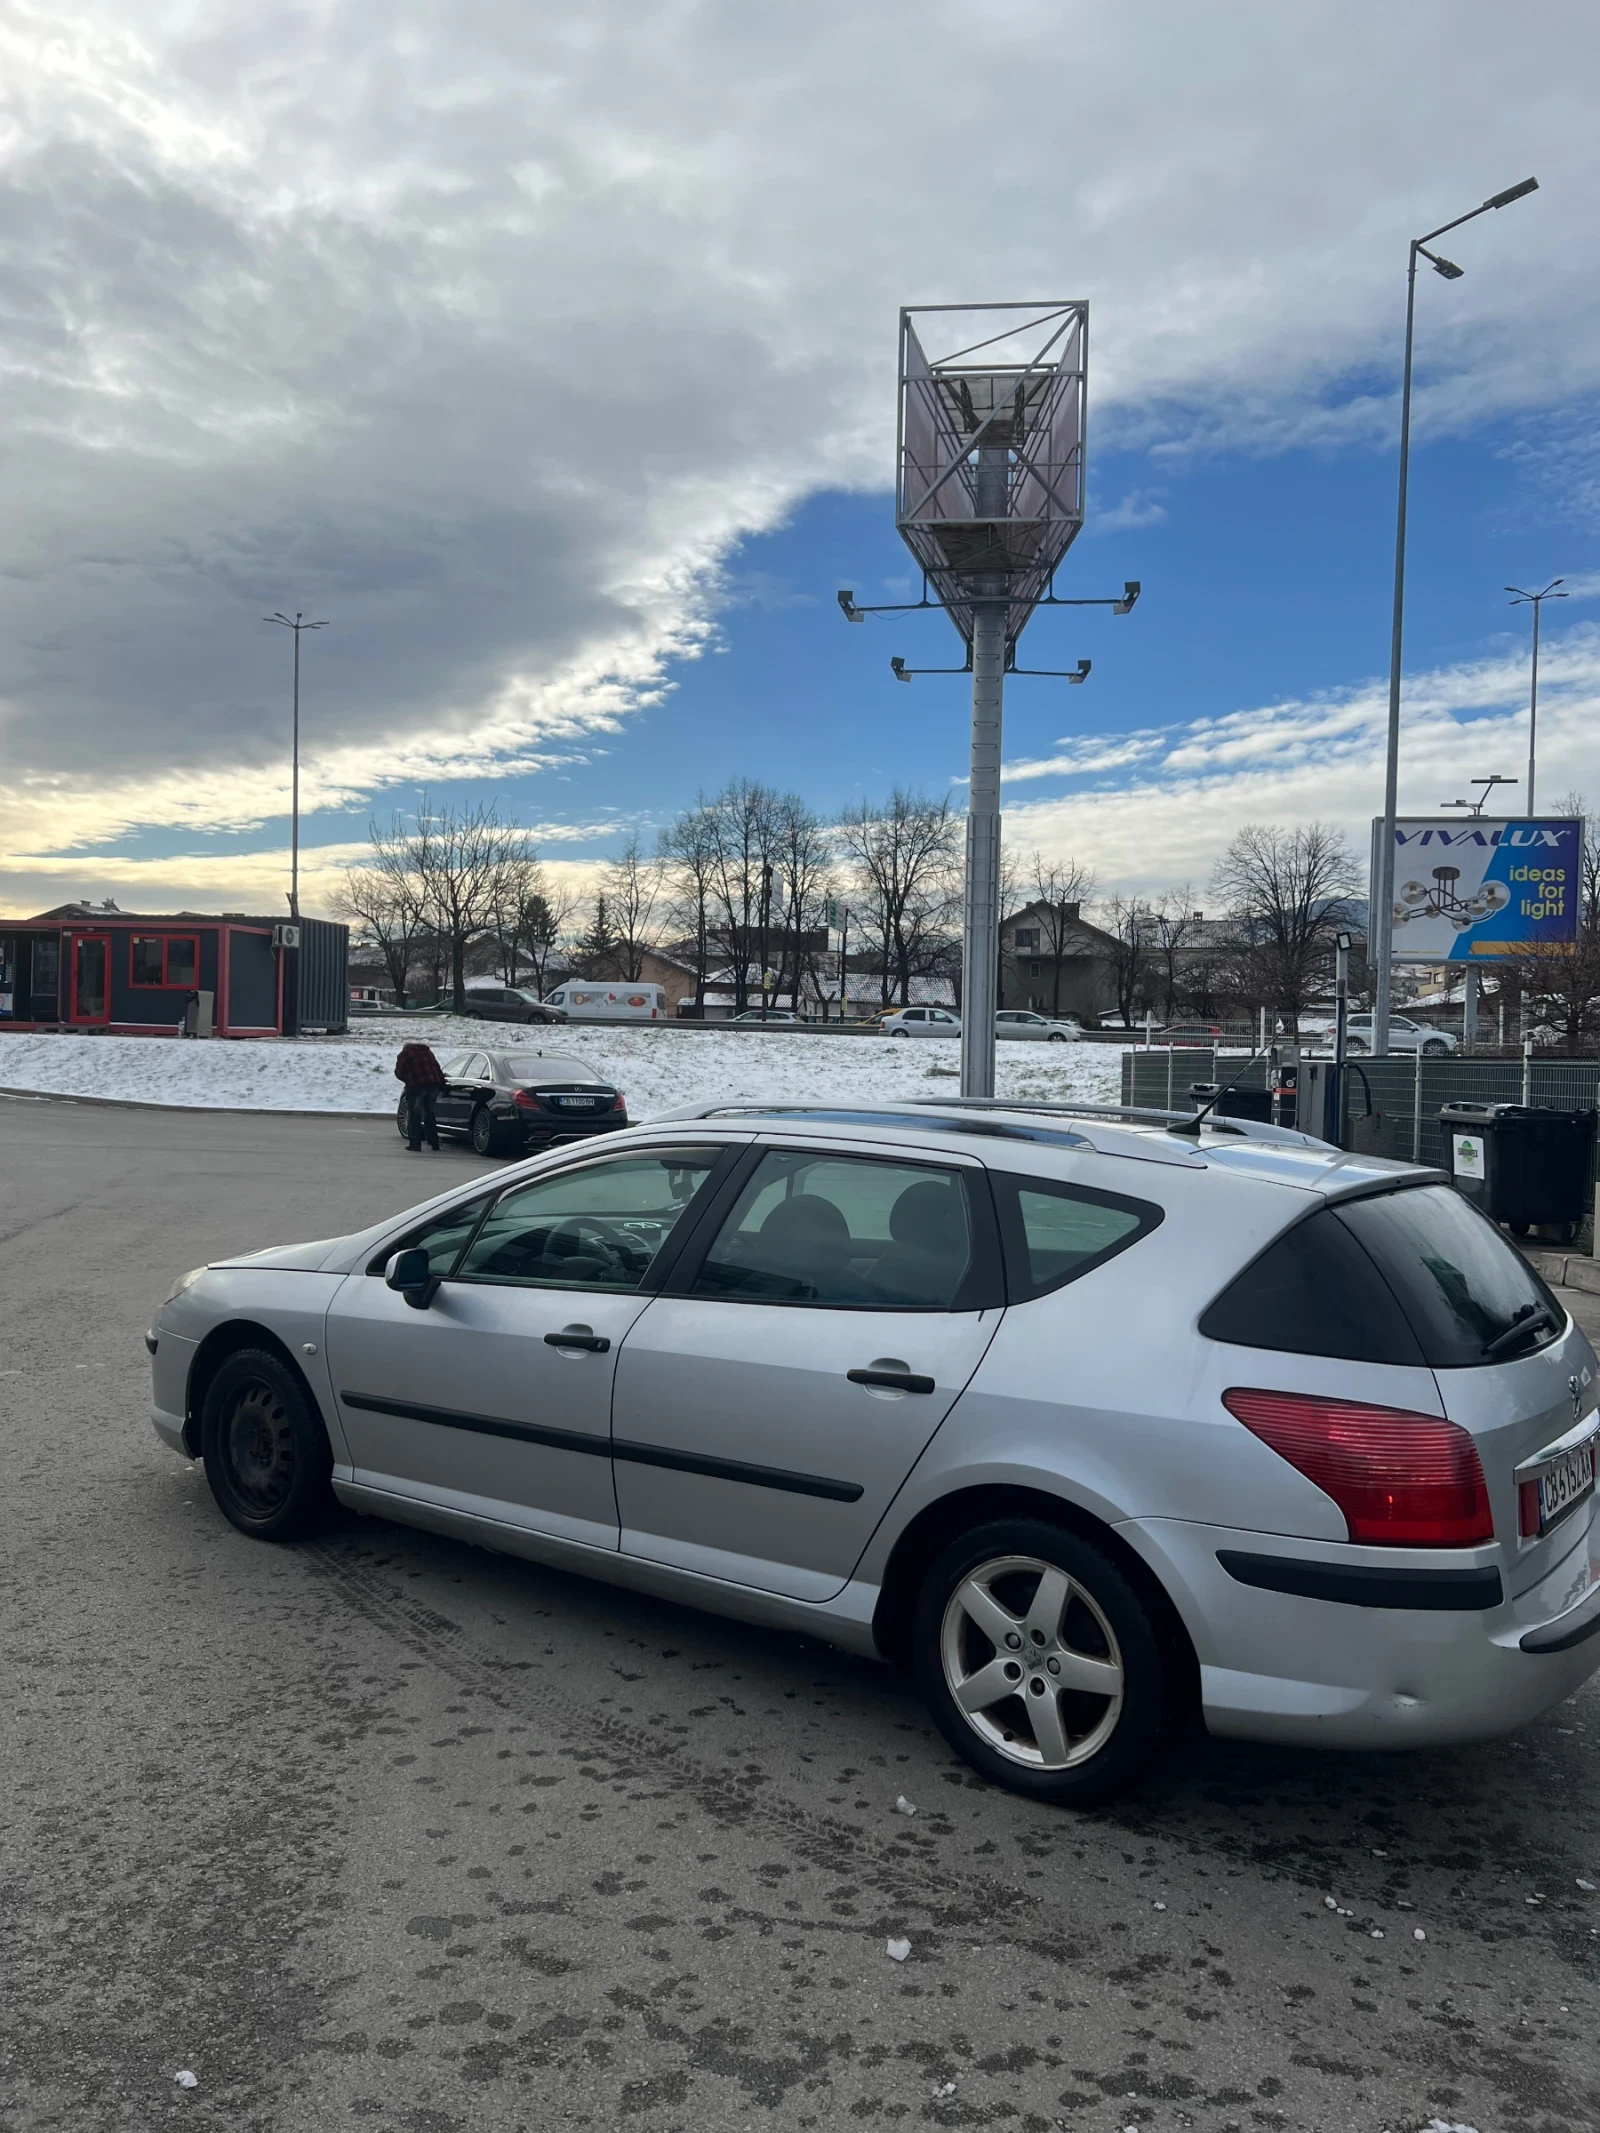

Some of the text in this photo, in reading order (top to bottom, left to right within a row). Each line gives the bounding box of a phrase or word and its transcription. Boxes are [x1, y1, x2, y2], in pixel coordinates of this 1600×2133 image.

[1509, 865, 1566, 882] ideas
[1538, 882, 1566, 899] for
[1520, 899, 1565, 920] light
